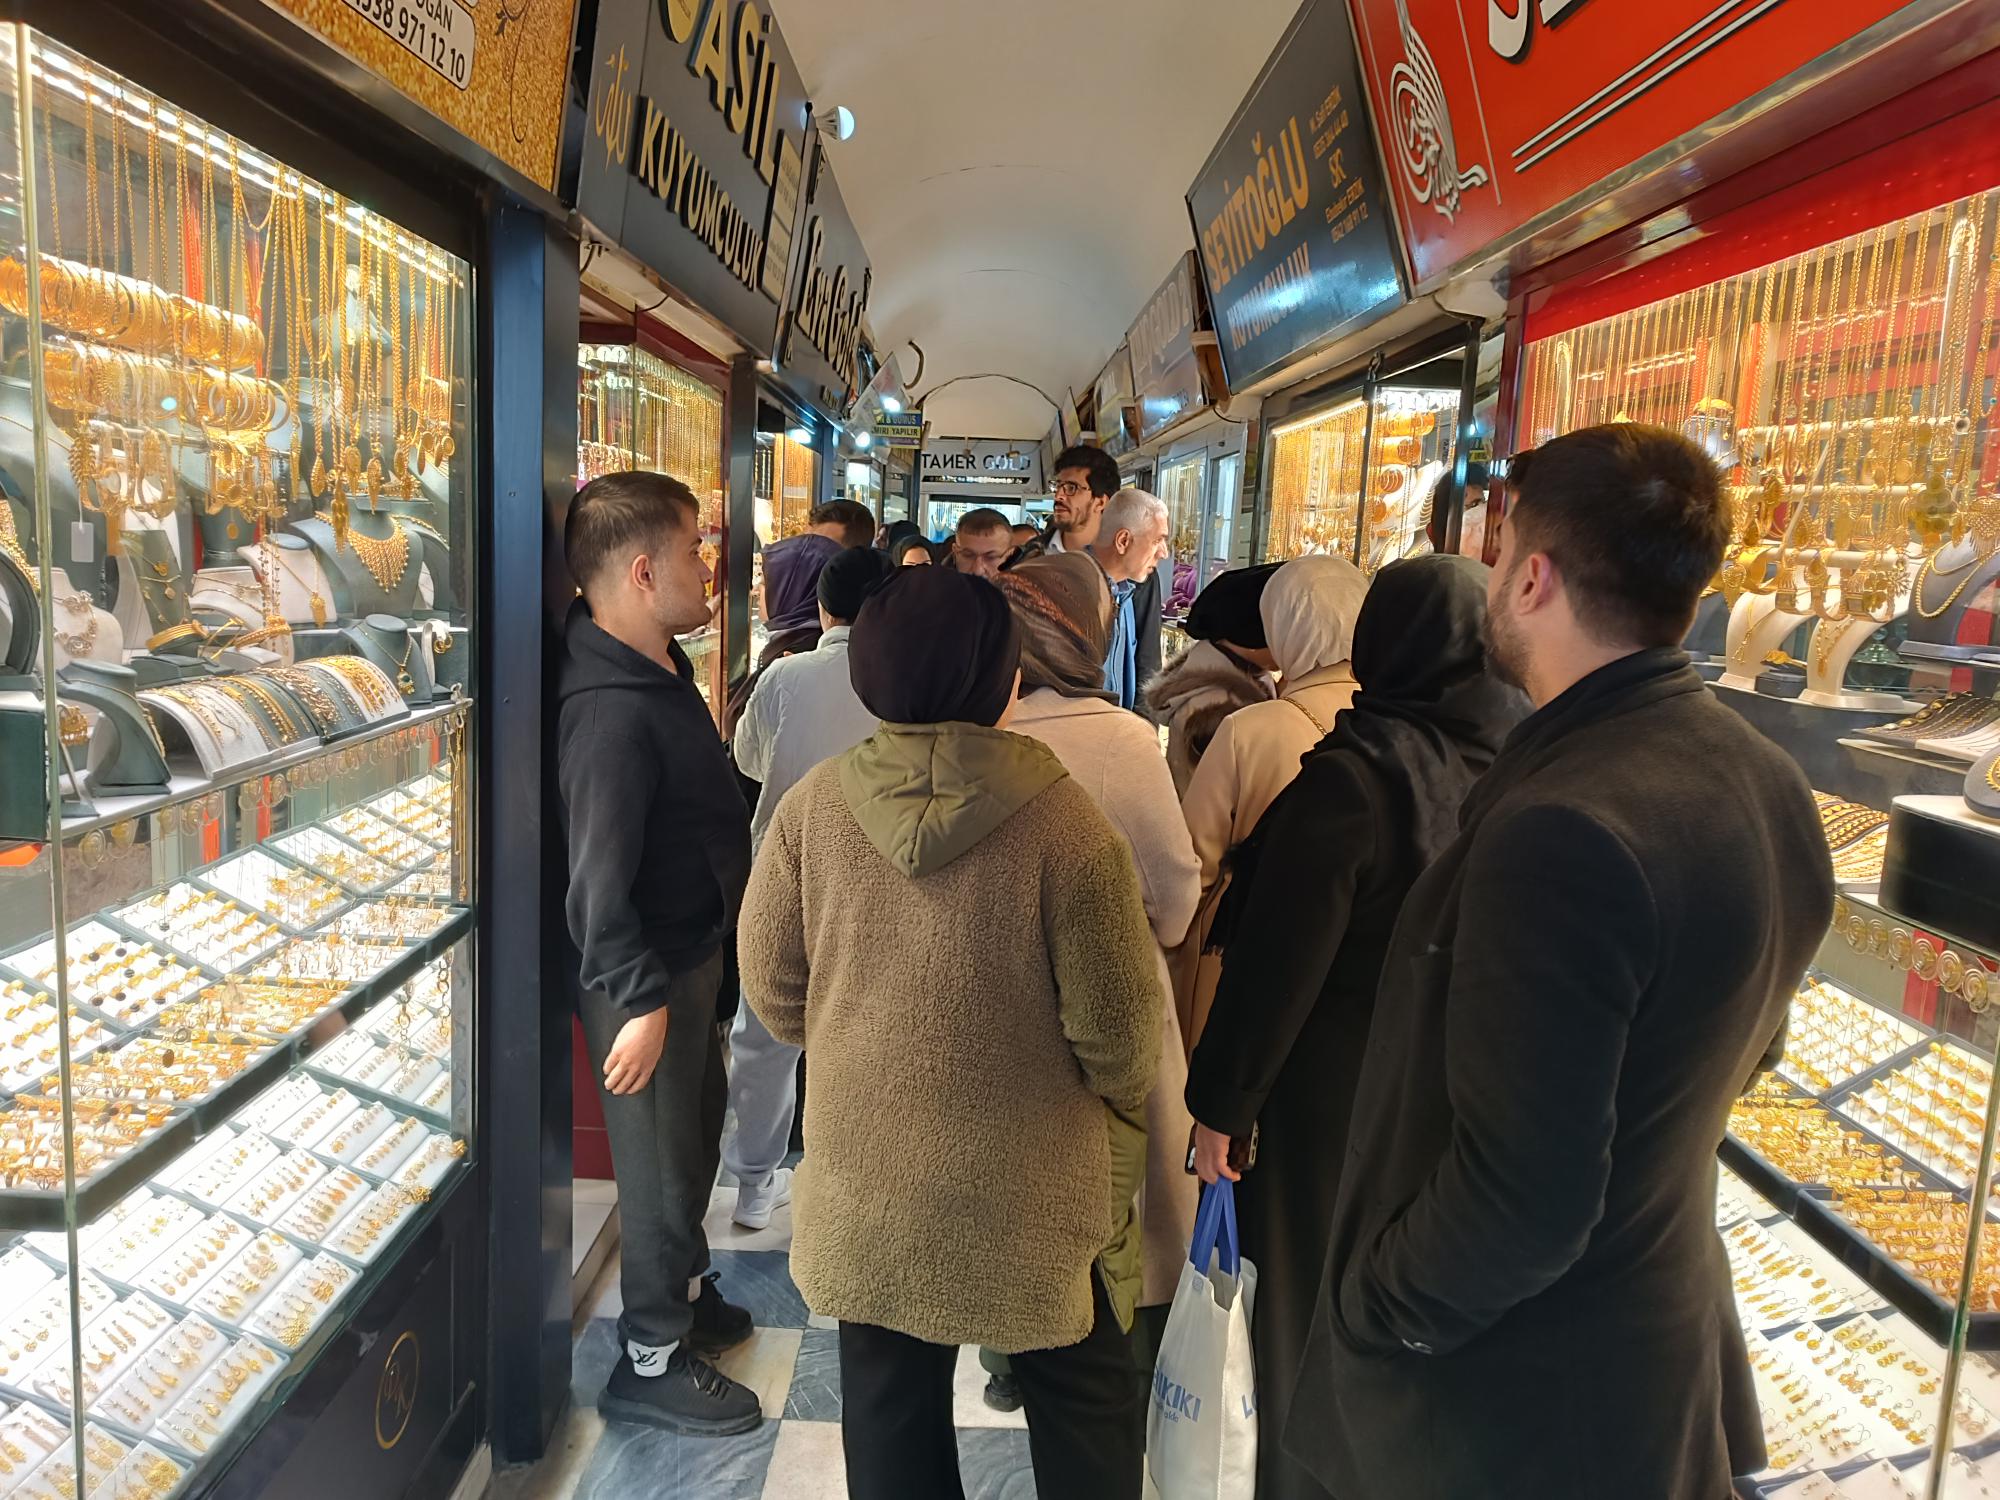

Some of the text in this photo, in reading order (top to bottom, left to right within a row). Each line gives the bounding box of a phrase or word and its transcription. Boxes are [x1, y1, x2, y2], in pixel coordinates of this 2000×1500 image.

[398, 7, 425, 54] 971
[431, 32, 446, 69] 12
[450, 48, 465, 83] 10
[638, 97, 764, 292] KUYUMCULUK
[1203, 115, 1309, 294] SEYİTOĞLU
